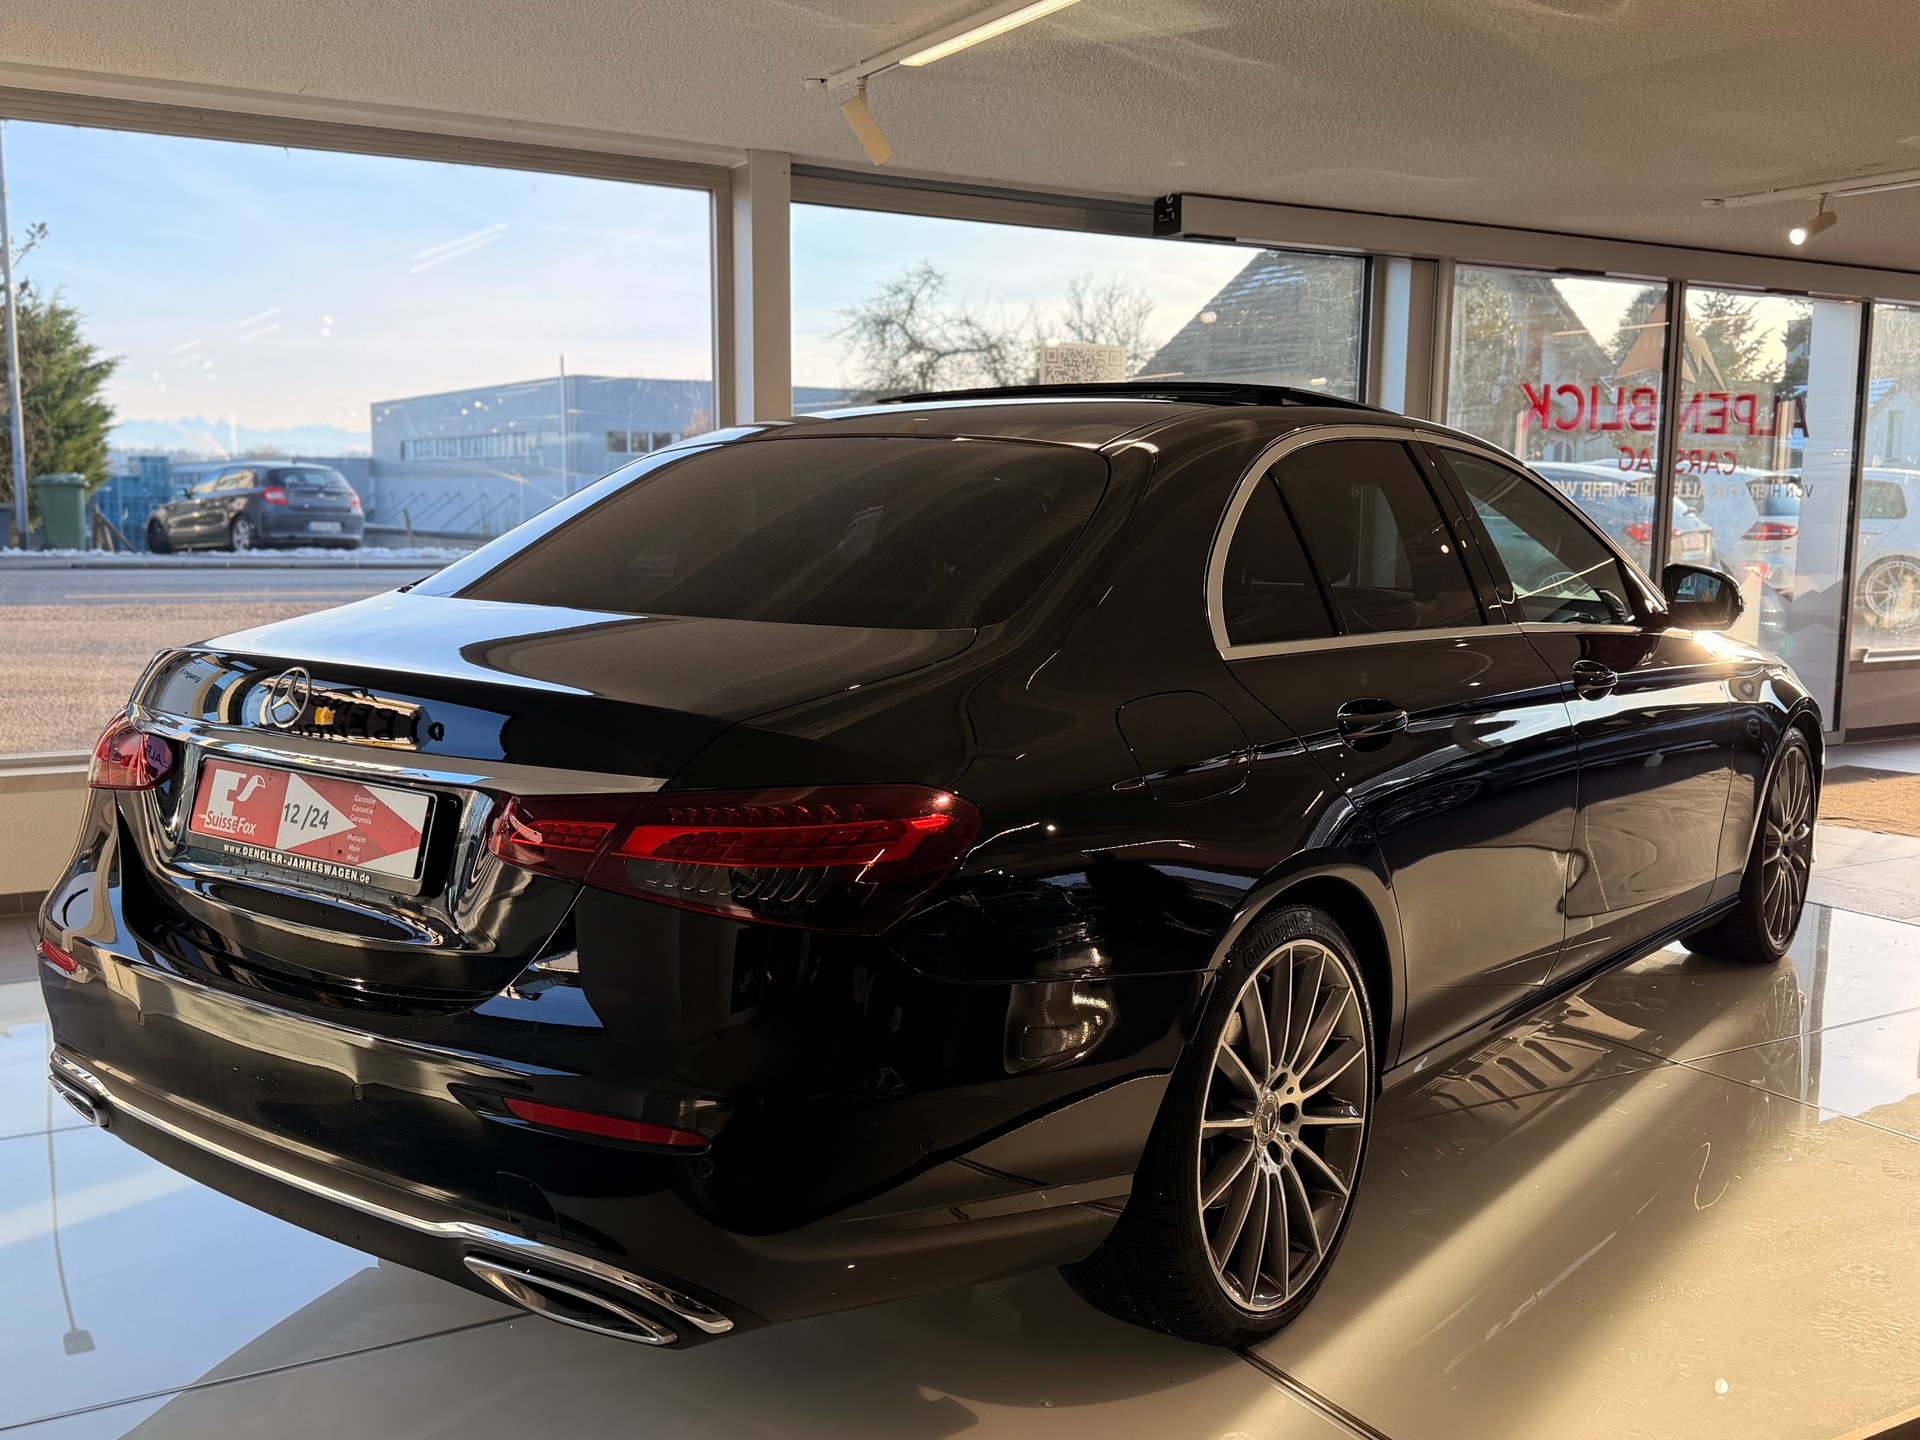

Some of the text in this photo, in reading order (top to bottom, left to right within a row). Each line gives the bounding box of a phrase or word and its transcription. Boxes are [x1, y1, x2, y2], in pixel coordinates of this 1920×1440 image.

[354, 794, 377, 805] Garantie
[352, 804, 374, 815] Garantie
[205, 810, 257, 836] SuisseFox
[346, 833, 367, 844] Monate
[223, 843, 371, 884] www.DENGLER-JAHRESWAGEN.de
[1242, 911, 1303, 972] Continental
